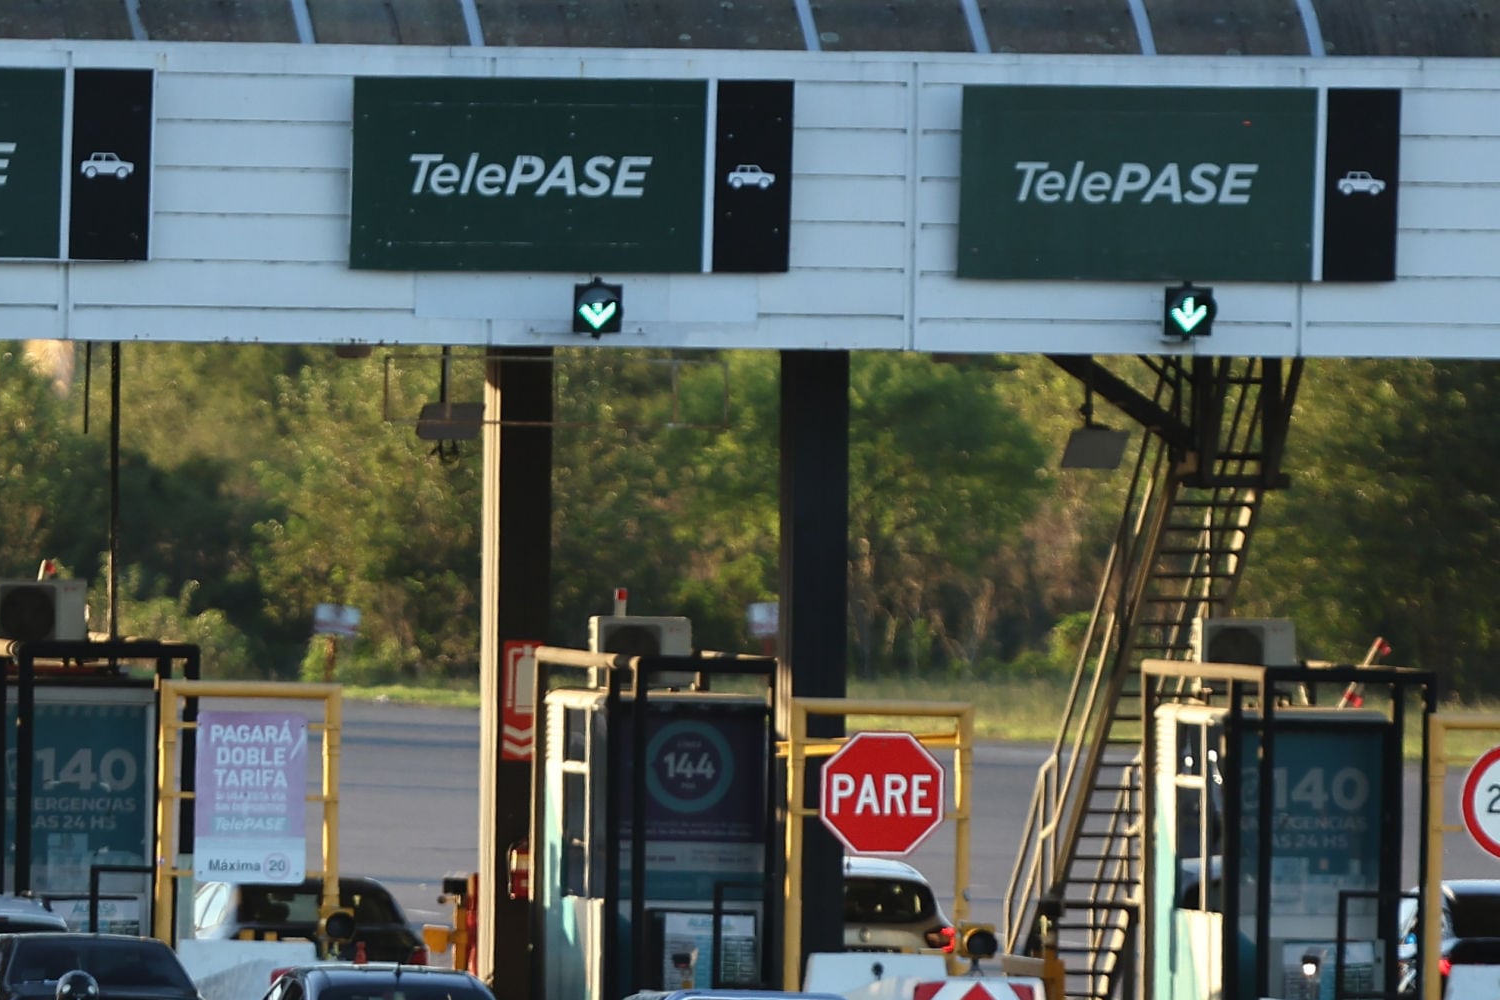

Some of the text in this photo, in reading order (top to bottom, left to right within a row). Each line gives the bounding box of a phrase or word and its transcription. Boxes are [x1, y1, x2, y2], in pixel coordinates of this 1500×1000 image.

[411, 152, 653, 196] TelePASE
[1016, 161, 1258, 203] TelePASE
[210, 720, 293, 744] PAGARÁ
[216, 747, 287, 766] DOBLE
[664, 752, 715, 779] 144
[35, 748, 137, 791] 140
[214, 769, 288, 788] TARIFA
[831, 773, 933, 815] PARE
[1274, 767, 1369, 811] 140
[62, 815, 86, 829] 24
[90, 815, 117, 830] HS
[215, 817, 287, 830] TelePASE
[208, 859, 286, 872] Máxima 20
